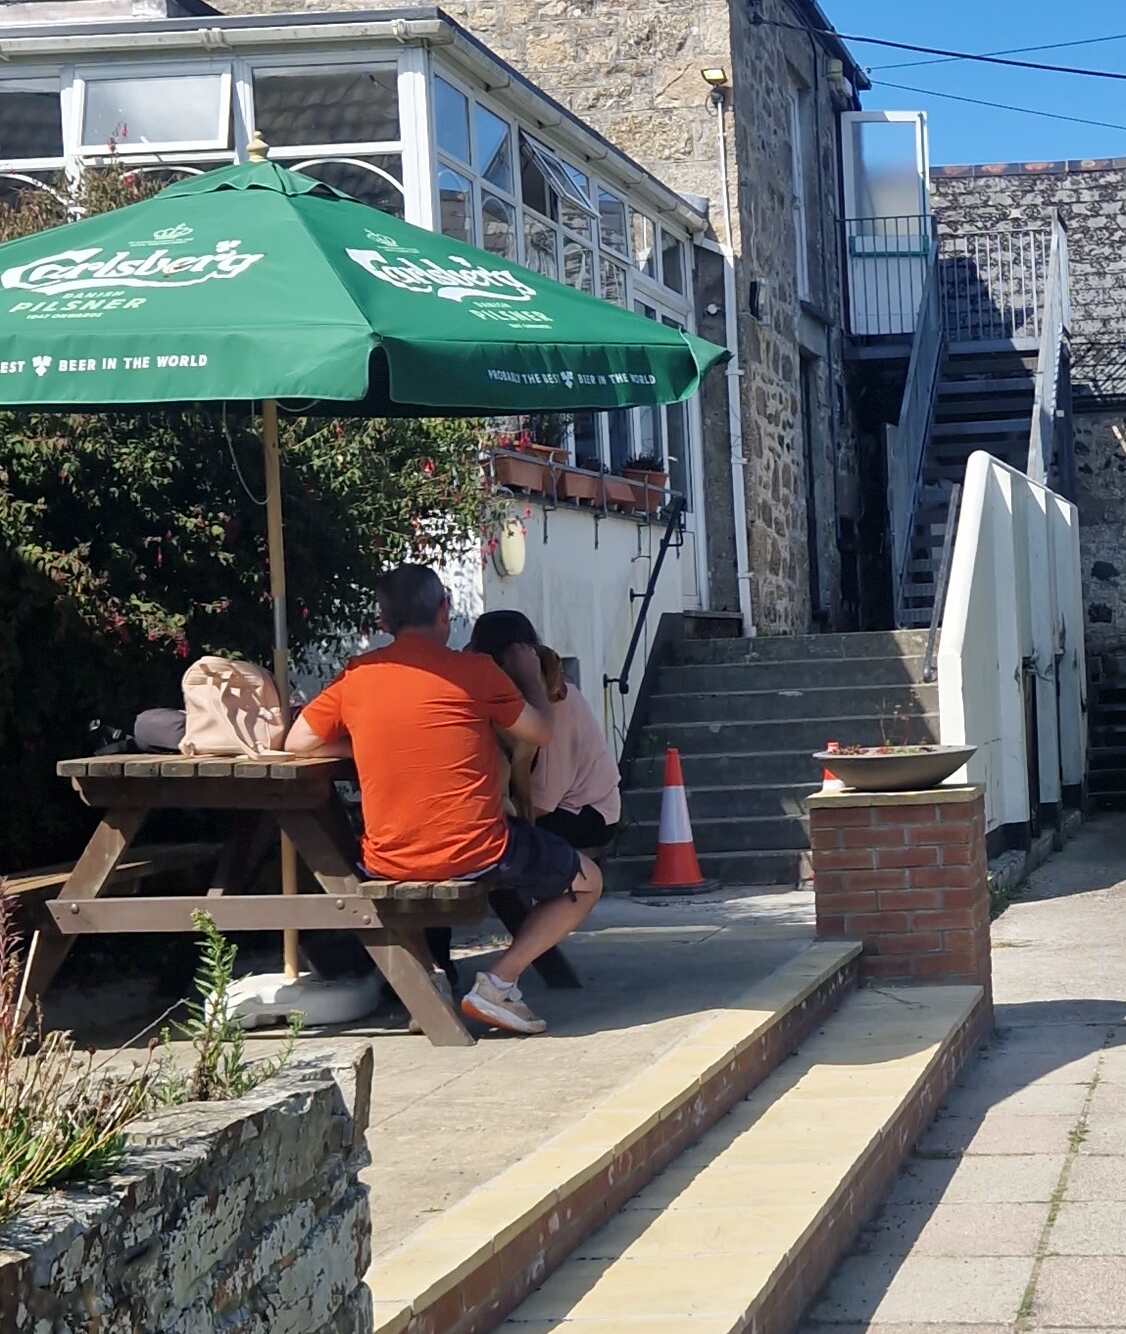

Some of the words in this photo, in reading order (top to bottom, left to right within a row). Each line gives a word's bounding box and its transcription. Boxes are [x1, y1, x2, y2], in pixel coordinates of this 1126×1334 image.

[1, 240, 265, 295] Carlsberg
[345, 247, 537, 303] Carlsberg
[62, 290, 126, 300] DANISH
[9, 298, 147, 313] PILSNER
[469, 310, 554, 322] PILSNER
[0, 362, 25, 373] EST
[58, 358, 97, 372] BEER
[102, 357, 118, 370] IN
[123, 356, 150, 370] THE
[156, 354, 208, 368] WORLD
[521, 373, 542, 385] THE
[577, 373, 597, 385] BEER
[597, 374, 607, 385] IN
[608, 372, 629, 385] THE
[629, 373, 657, 385] WORLD
